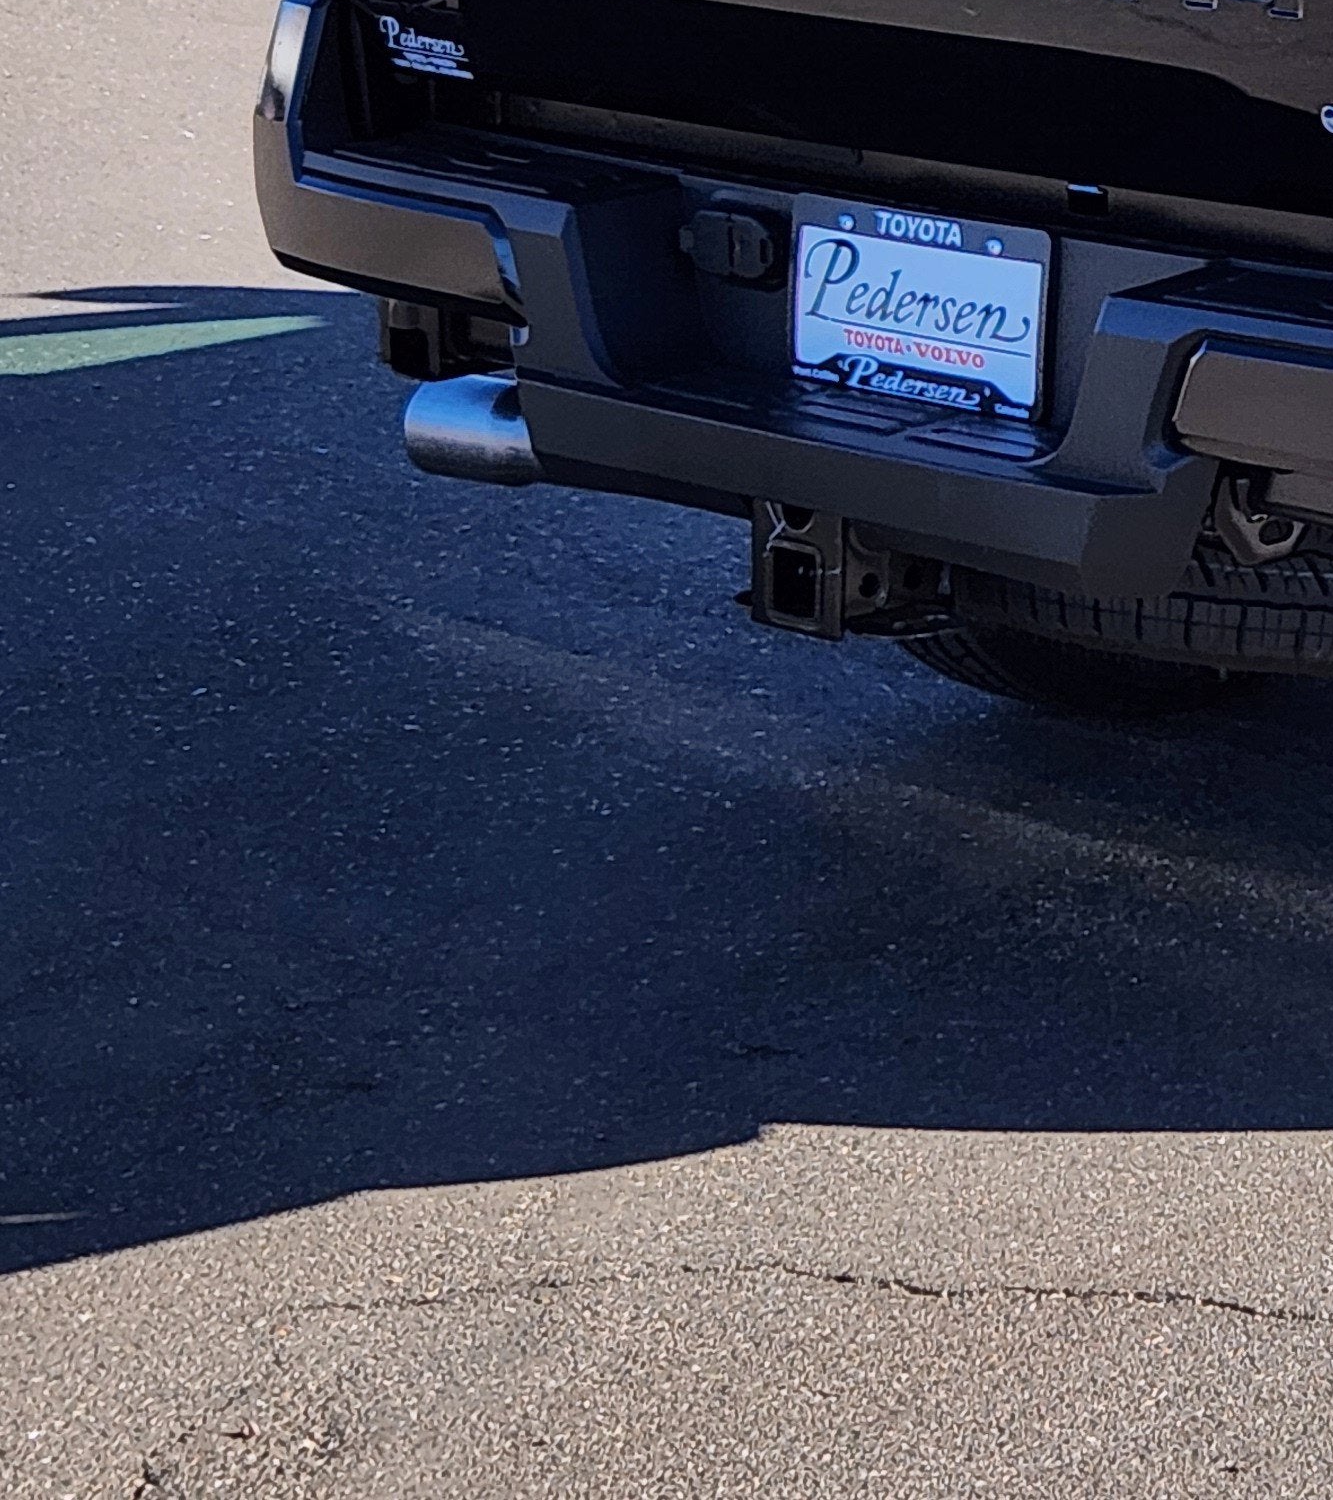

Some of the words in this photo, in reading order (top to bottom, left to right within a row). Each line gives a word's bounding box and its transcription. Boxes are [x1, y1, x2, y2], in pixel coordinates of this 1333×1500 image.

[379, 15, 465, 56] Pedersen
[874, 209, 963, 249] TOYOTA
[804, 238, 1032, 344] Pedersen
[843, 354, 982, 406] Pedersen
